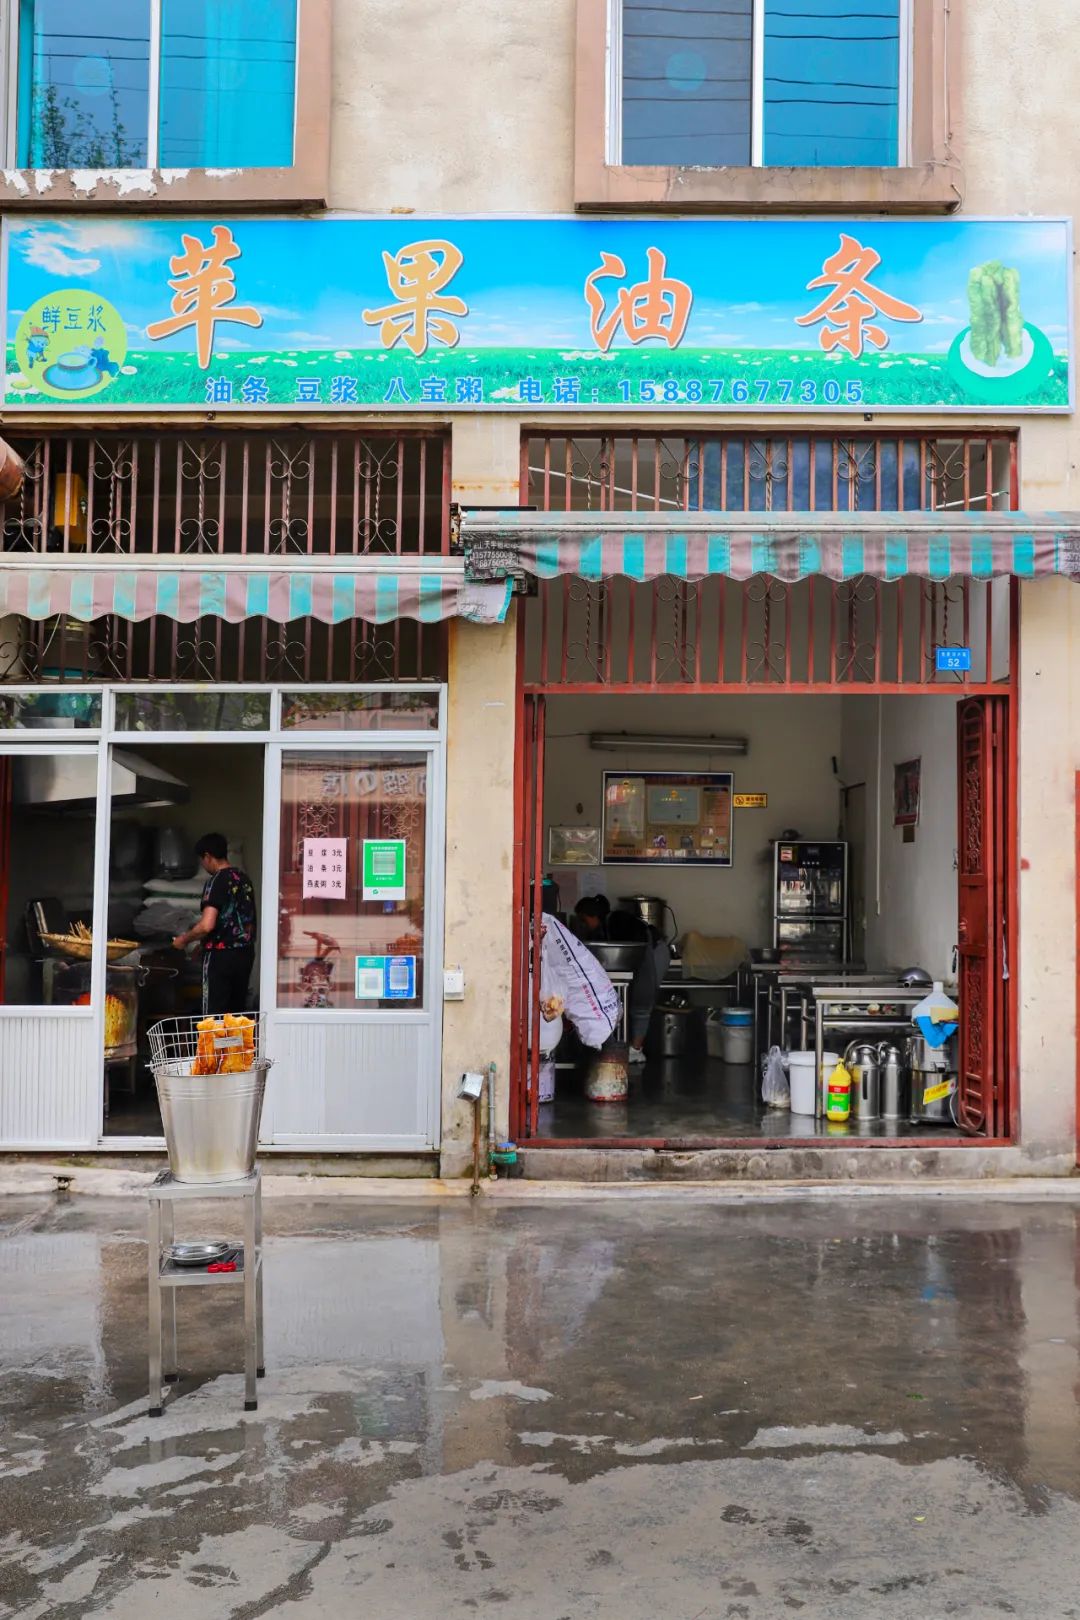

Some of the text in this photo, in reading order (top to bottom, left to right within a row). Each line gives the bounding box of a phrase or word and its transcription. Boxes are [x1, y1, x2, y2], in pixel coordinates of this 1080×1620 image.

[147, 226, 922, 370] 苹果油条
[41, 305, 107, 333] 鲜豆浆
[204, 377, 270, 404] 油条
[294, 377, 359, 404] 豆浆
[384, 377, 484, 404] 八宝粥
[948, 658, 959, 667] 52
